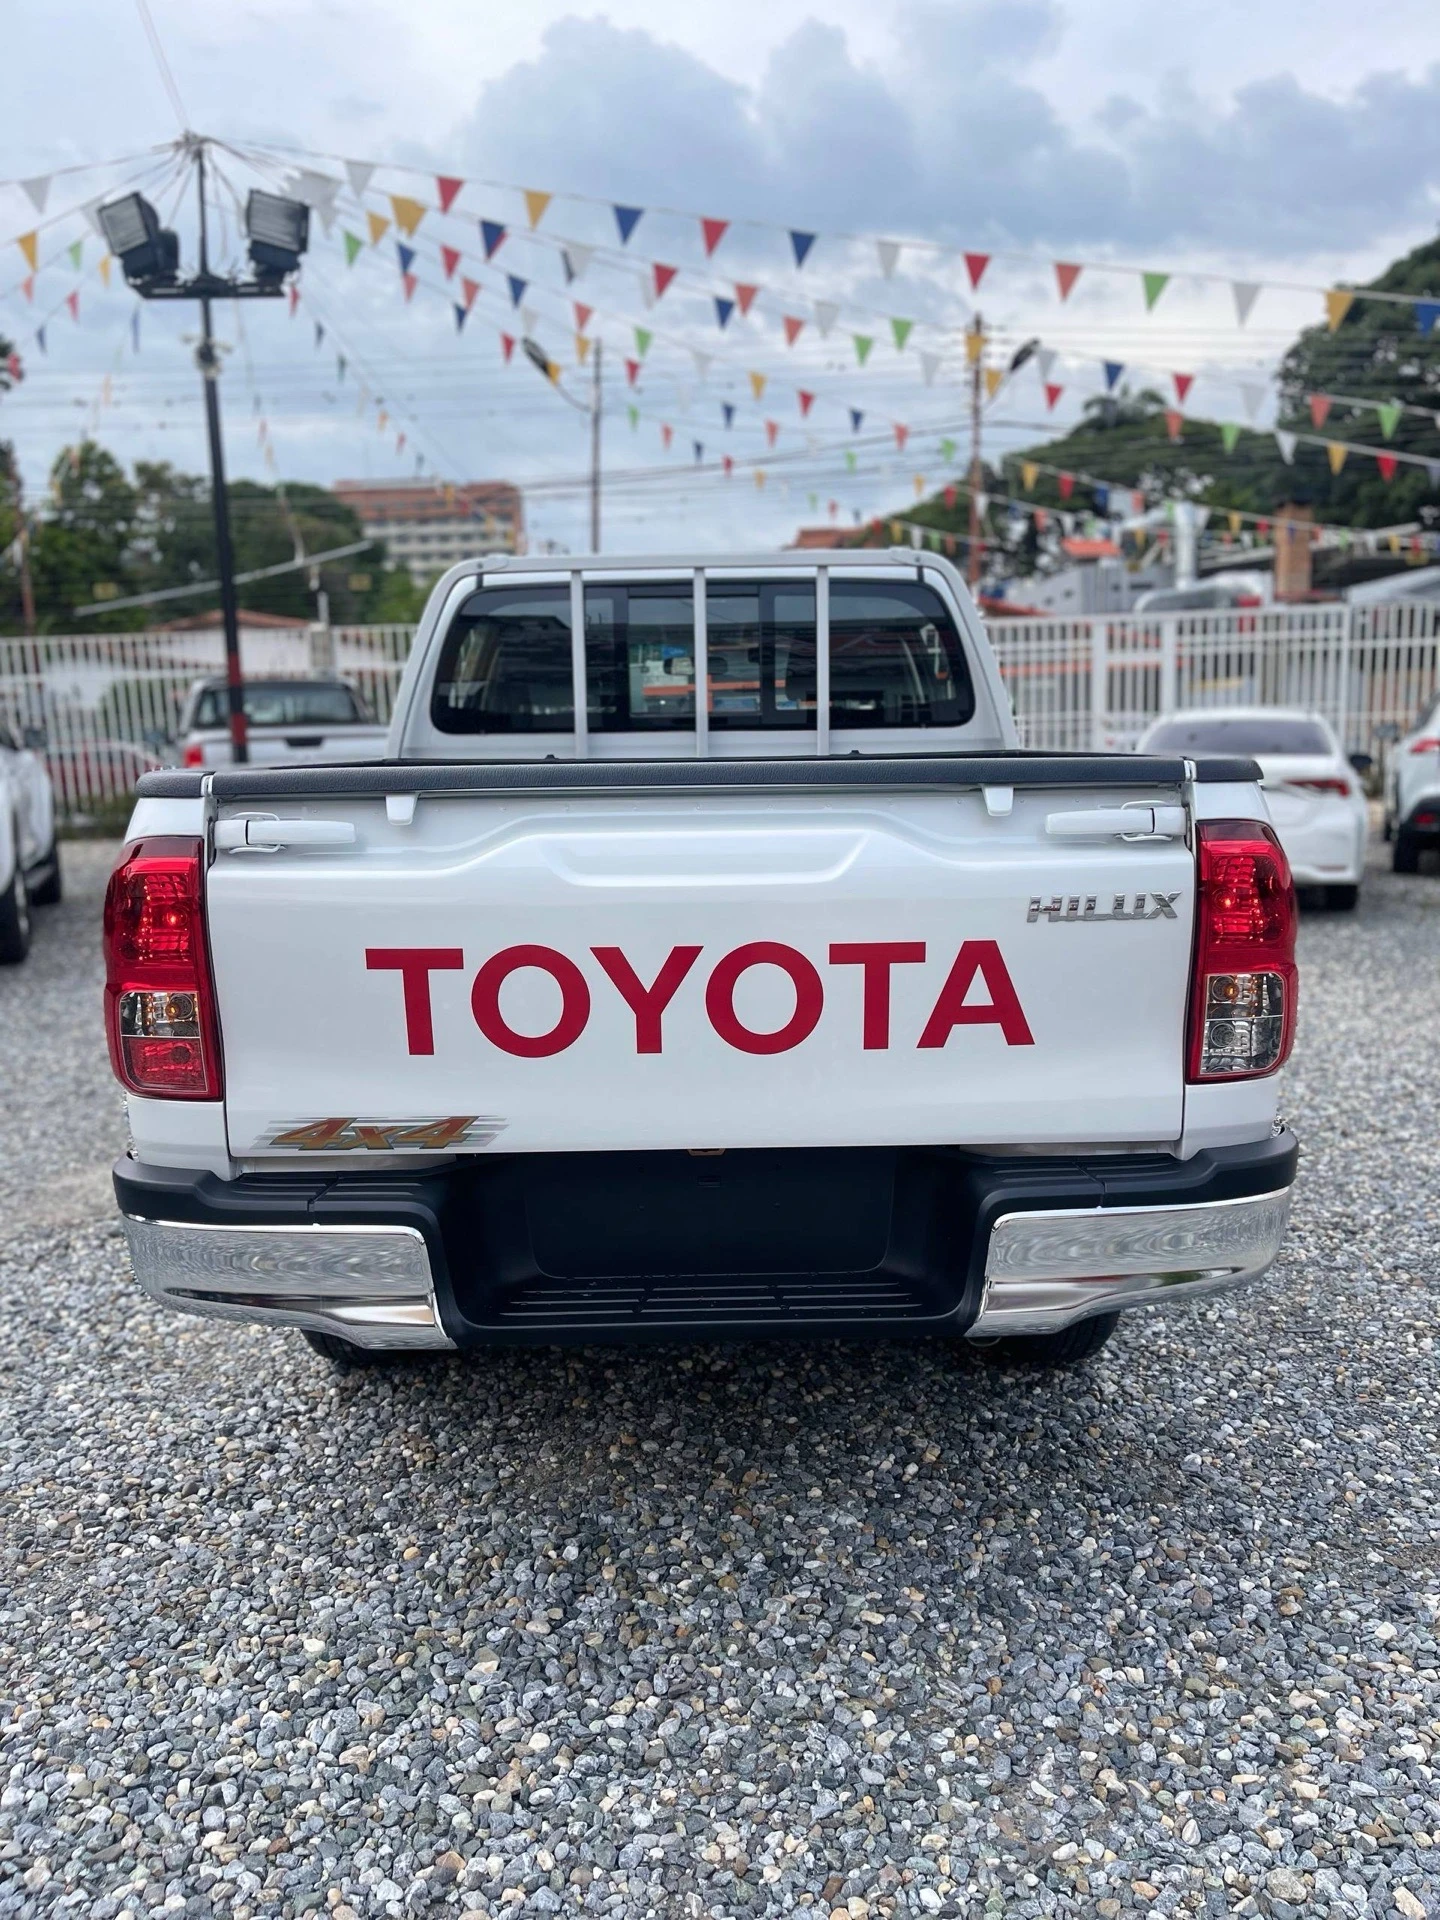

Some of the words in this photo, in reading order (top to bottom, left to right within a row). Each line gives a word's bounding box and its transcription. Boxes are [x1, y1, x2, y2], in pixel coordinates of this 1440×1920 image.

[1027, 891, 1182, 922] HILUX
[365, 940, 1036, 1059] TOYOTA
[269, 1115, 481, 1151] 4x4
